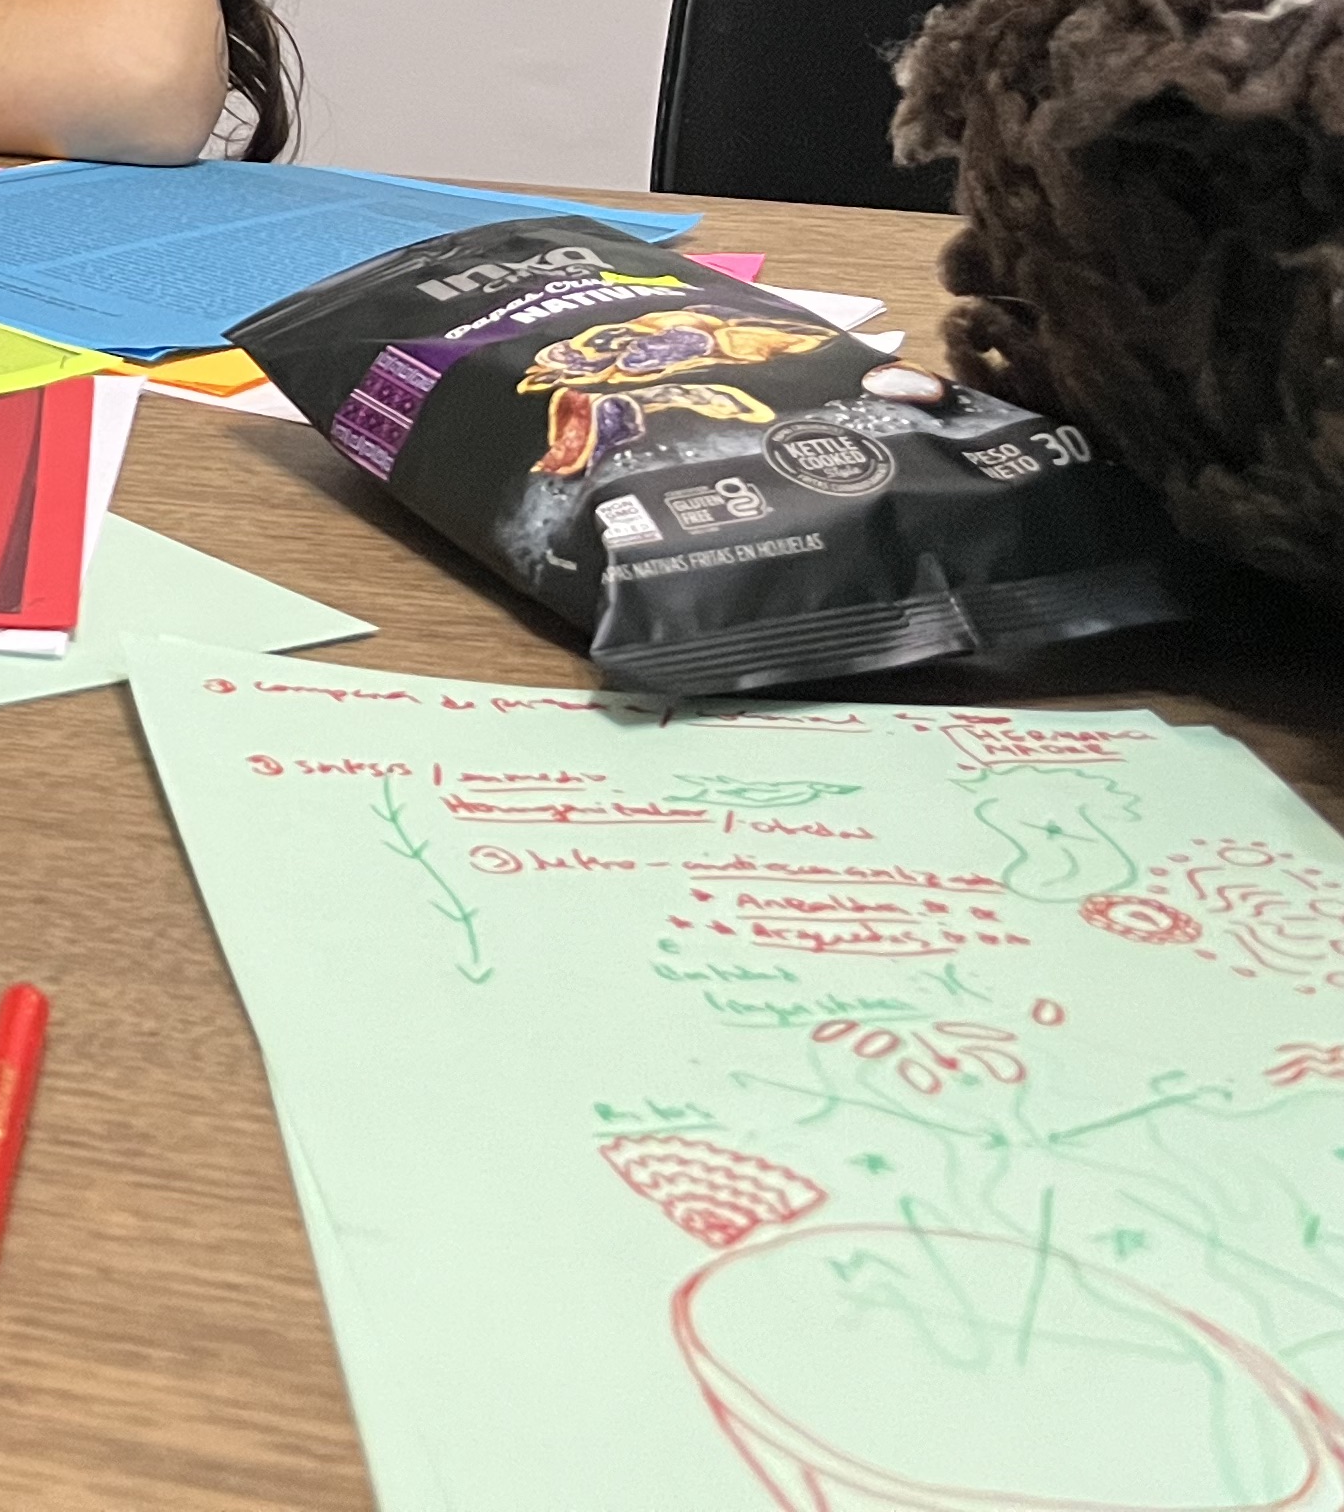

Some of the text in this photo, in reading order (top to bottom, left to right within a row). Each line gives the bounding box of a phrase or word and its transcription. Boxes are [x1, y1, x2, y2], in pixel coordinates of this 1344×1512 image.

[783, 436, 859, 459] KETTLE
[798, 450, 867, 471] COOKED
[671, 493, 725, 512] GLUTEN
[680, 509, 715, 525] FREE
[688, 547, 736, 569] FRITAS
[734, 544, 757, 562] EN
